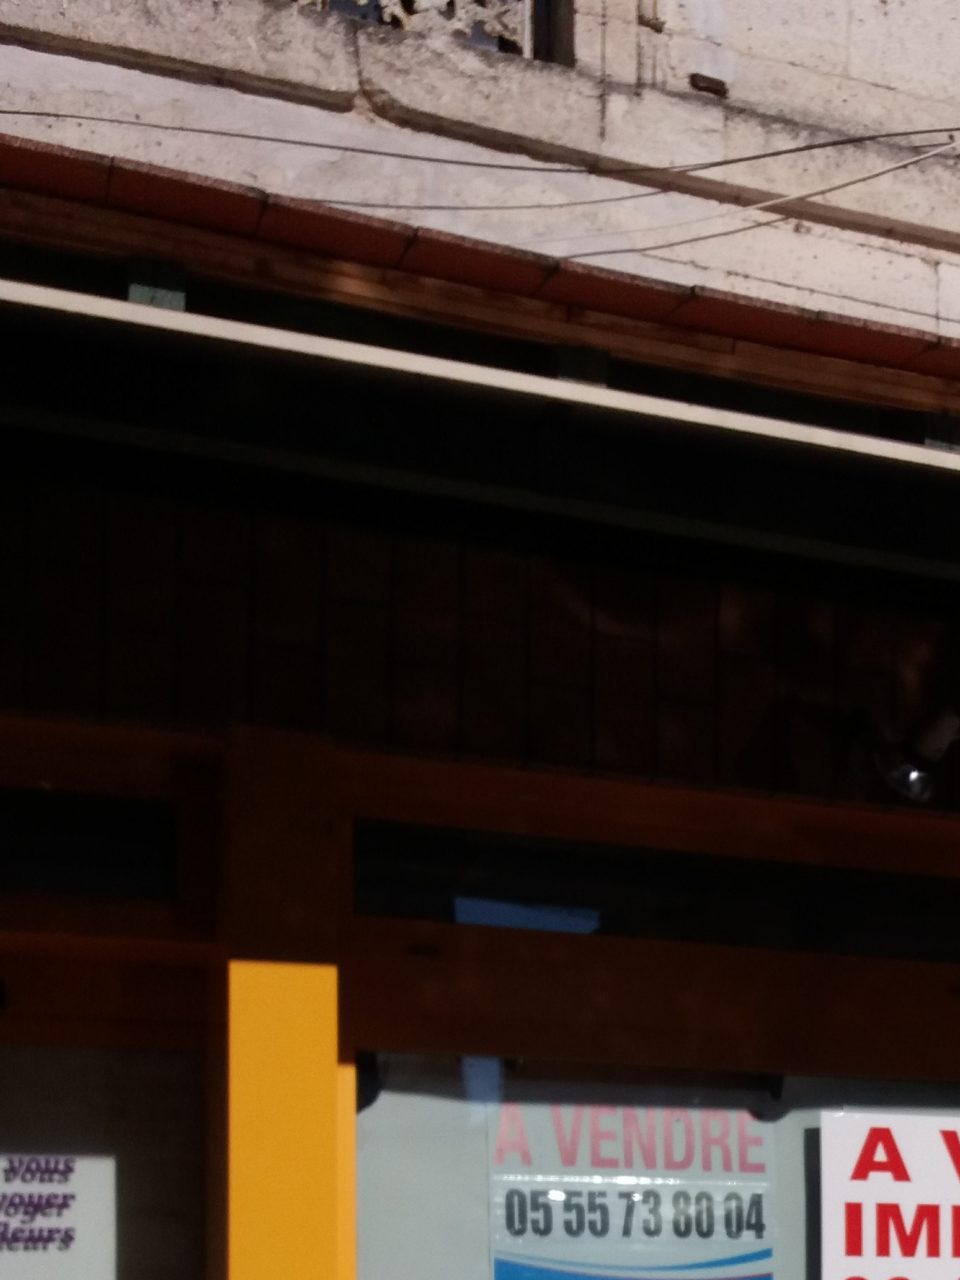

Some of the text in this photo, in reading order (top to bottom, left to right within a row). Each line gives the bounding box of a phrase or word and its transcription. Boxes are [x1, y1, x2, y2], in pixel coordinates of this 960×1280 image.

[493, 1101, 767, 1174] A VENDRE
[850, 1127, 911, 1182] A
[505, 1188, 766, 1239] 05 55 73 80 04
